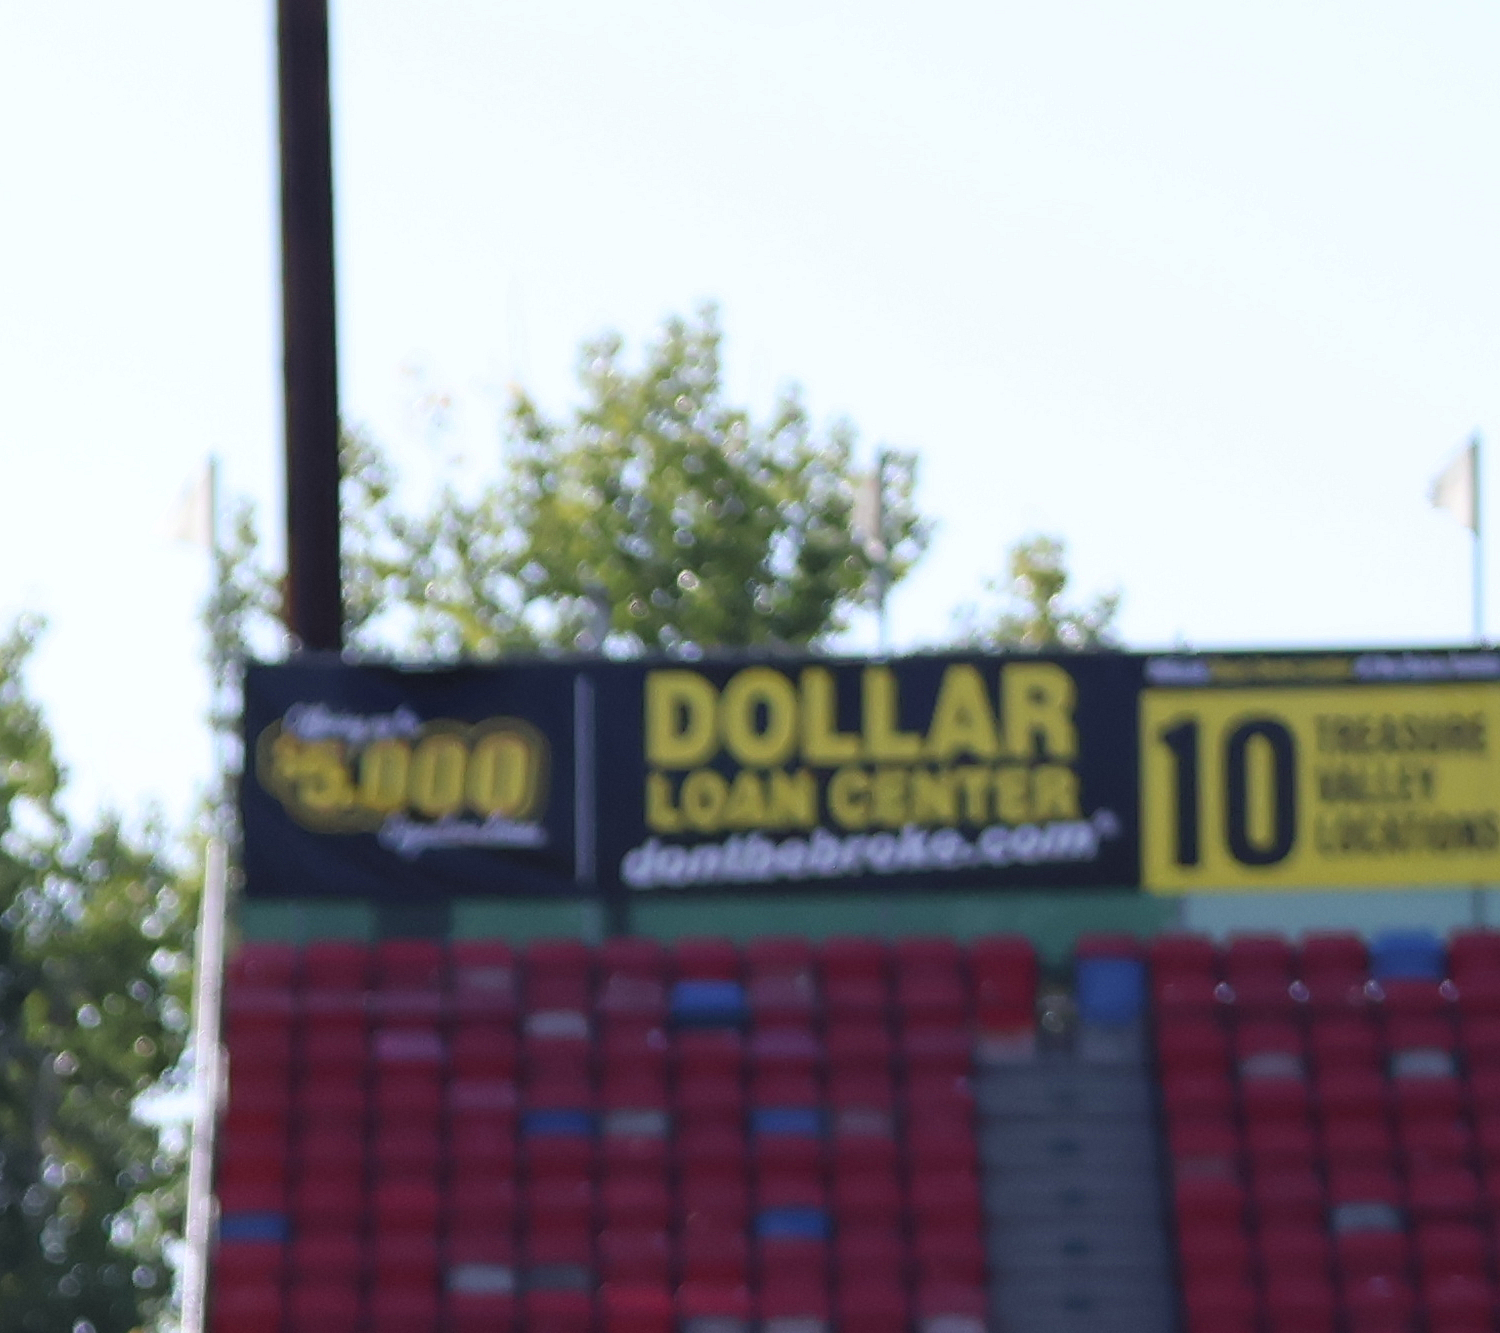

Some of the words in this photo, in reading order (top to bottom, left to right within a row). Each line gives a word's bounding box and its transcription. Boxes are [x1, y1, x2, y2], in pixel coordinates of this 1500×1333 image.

[644, 662, 1077, 768] DOLLAR
[646, 768, 818, 831] LOAN
[827, 764, 1079, 830] CENTER
[1159, 714, 1297, 867] 10
